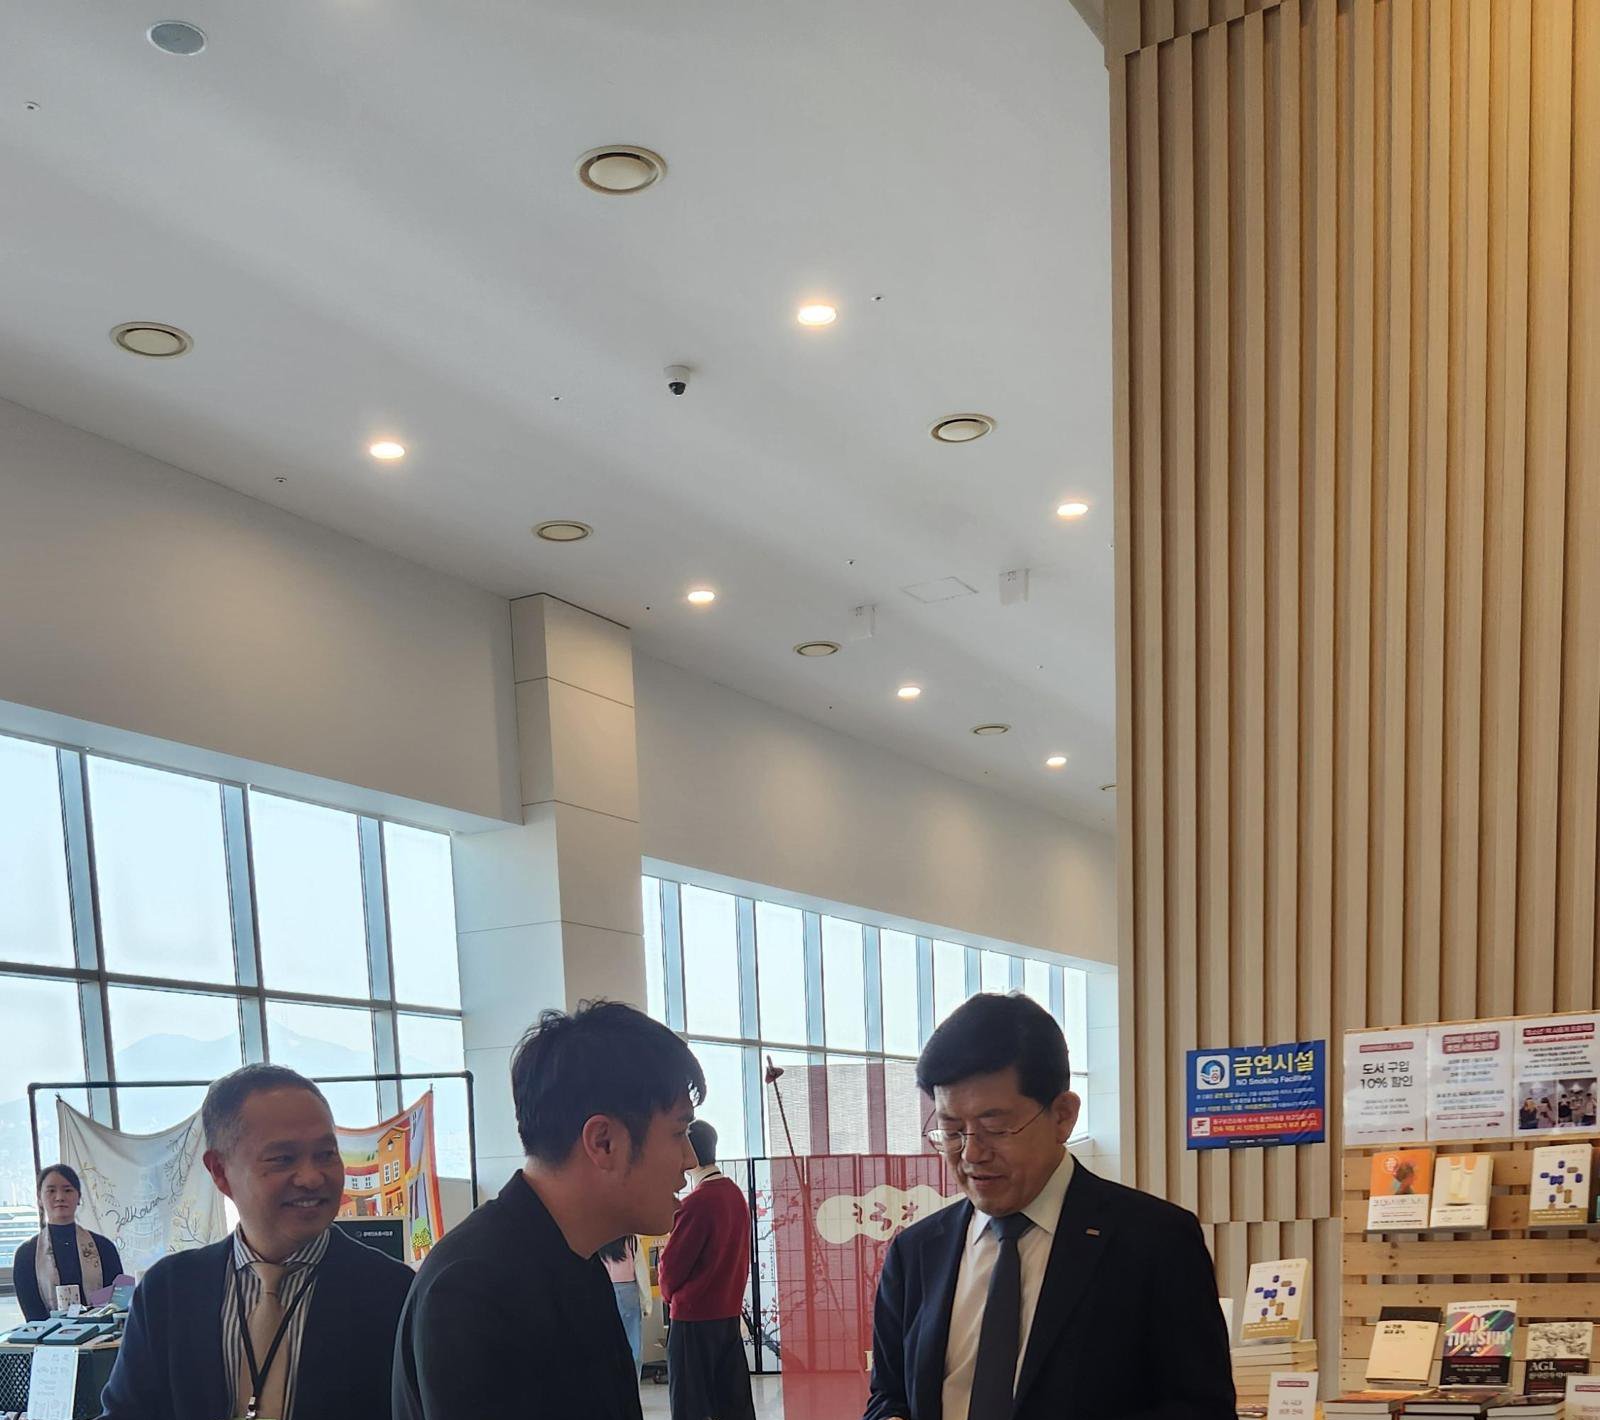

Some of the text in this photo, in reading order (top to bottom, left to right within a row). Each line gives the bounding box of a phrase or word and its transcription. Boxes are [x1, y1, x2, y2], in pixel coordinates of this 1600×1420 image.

[1233, 1050, 1314, 1077] 금연시설
[1362, 1061, 1410, 1075] 도서 구입
[1360, 1075, 1413, 1089] 10% 할인
